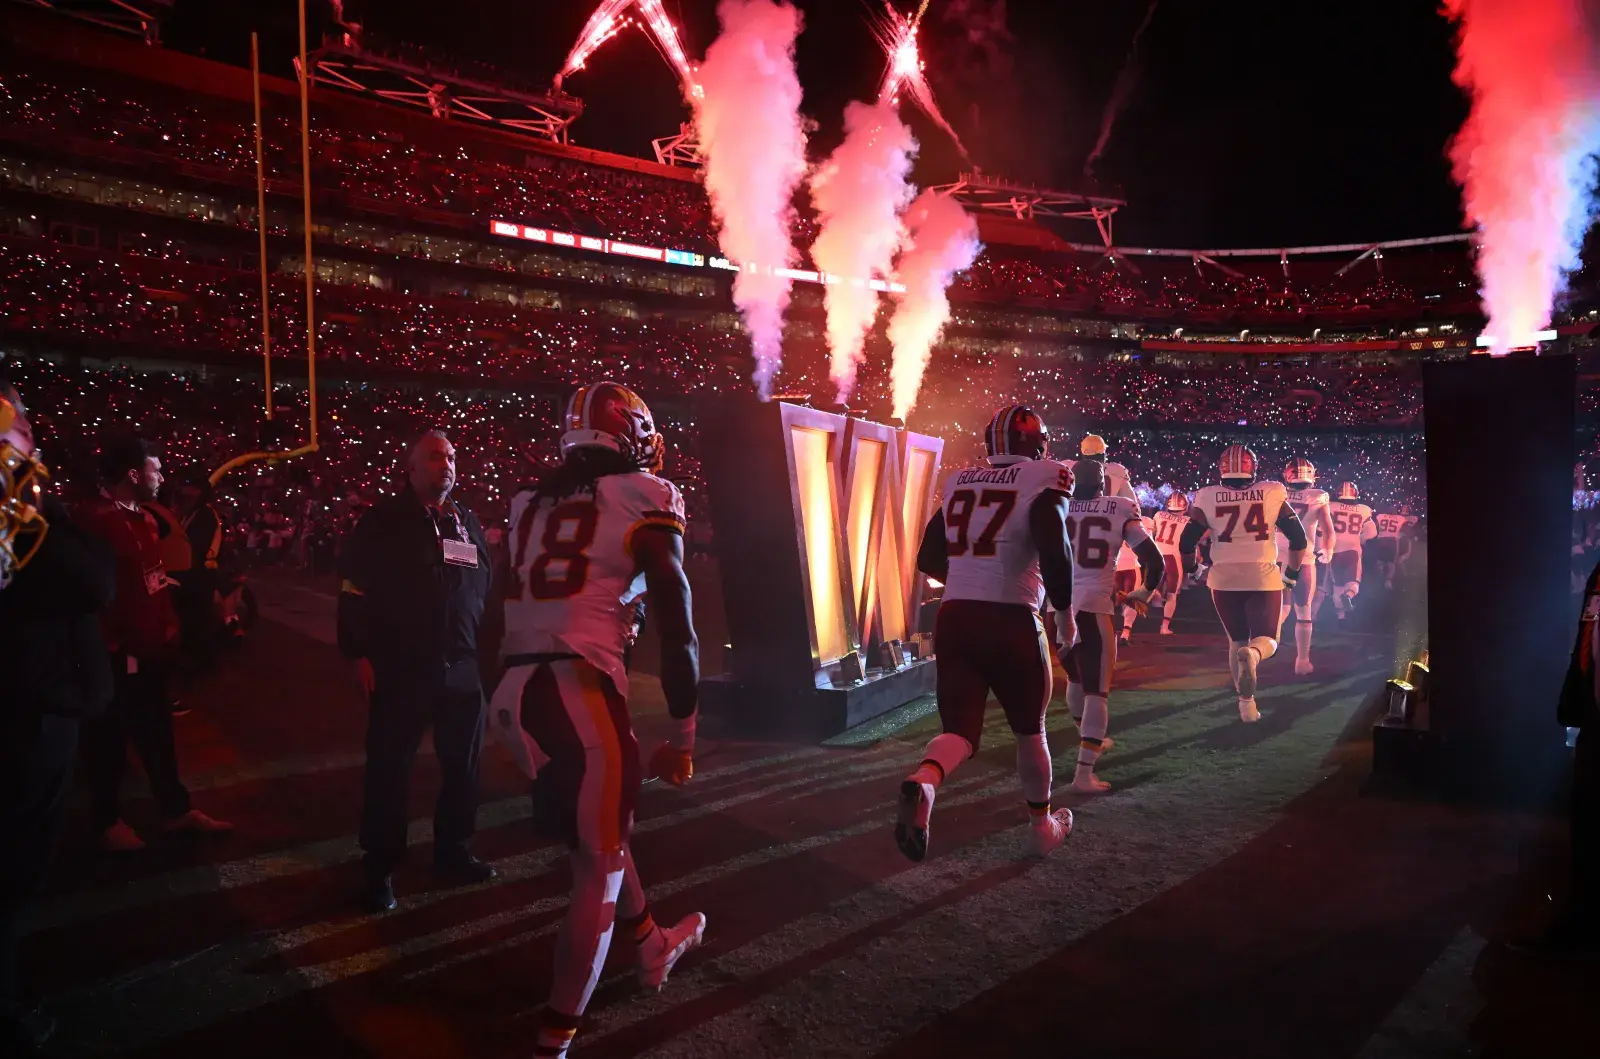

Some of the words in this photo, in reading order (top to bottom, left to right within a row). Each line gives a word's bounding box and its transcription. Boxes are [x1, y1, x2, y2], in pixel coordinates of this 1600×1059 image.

[1432, 340, 1445, 349] W
[957, 467, 1021, 485] GOLDMAN
[1102, 501, 1117, 515] JR
[1215, 490, 1264, 503] COLEMAN
[945, 488, 1019, 558] 97
[1156, 520, 1178, 546] 11
[1215, 503, 1269, 543] 74
[1334, 511, 1362, 534] 58
[1380, 519, 1399, 533] 95
[780, 401, 945, 668] W
[502, 499, 598, 600] 18
